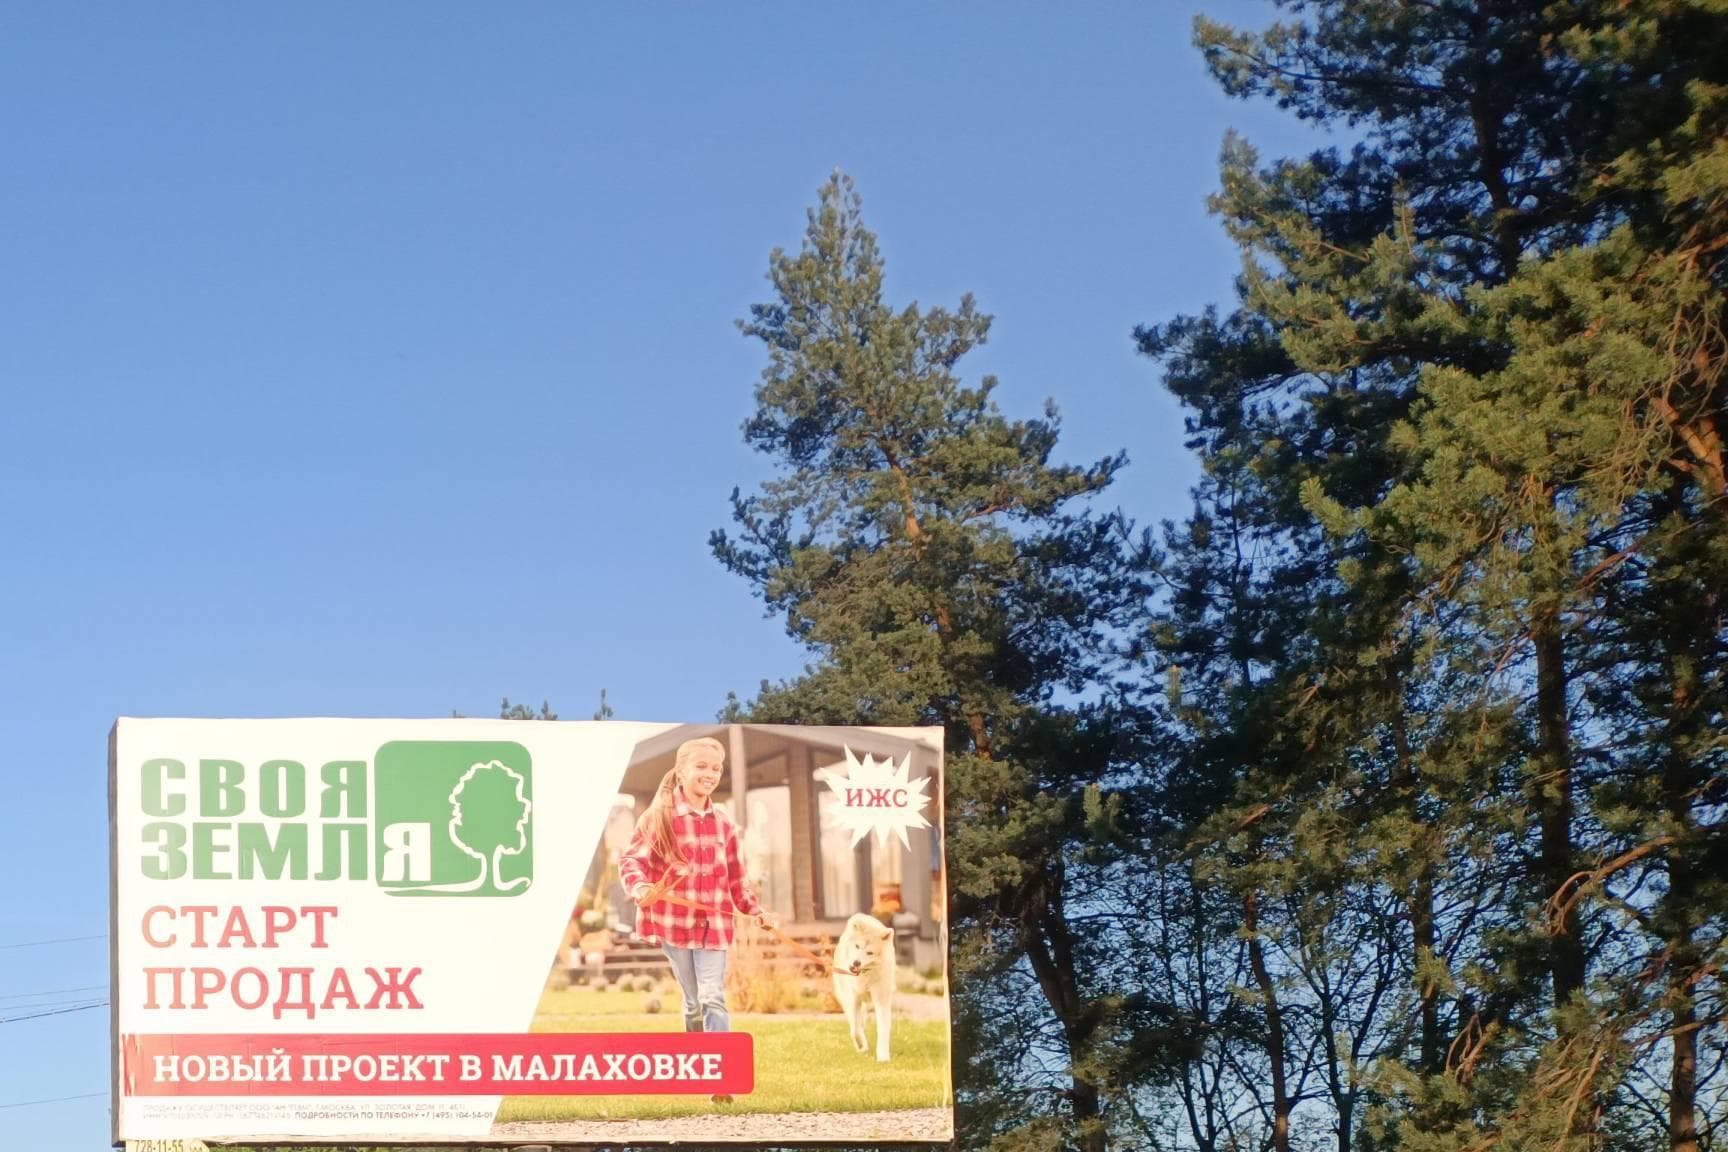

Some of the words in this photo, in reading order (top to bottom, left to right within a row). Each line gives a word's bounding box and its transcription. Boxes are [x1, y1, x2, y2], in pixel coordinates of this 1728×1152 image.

[141, 758, 368, 818] СВОЯ
[844, 787, 909, 808] ИЖС
[141, 822, 431, 881] ЗЕМЛЯ
[141, 905, 339, 949] СТАРТ
[142, 967, 425, 1020] ПРОДАЖ
[153, 1046, 292, 1084] НОВЫЙ
[302, 1054, 454, 1084] ПРОЕКТ
[461, 1054, 484, 1083] В
[491, 1053, 724, 1083] МАЛАХОВКЕ
[294, 1111, 359, 1119] ПОДРОБНОСТИ
[360, 1111, 374, 1119] ПО
